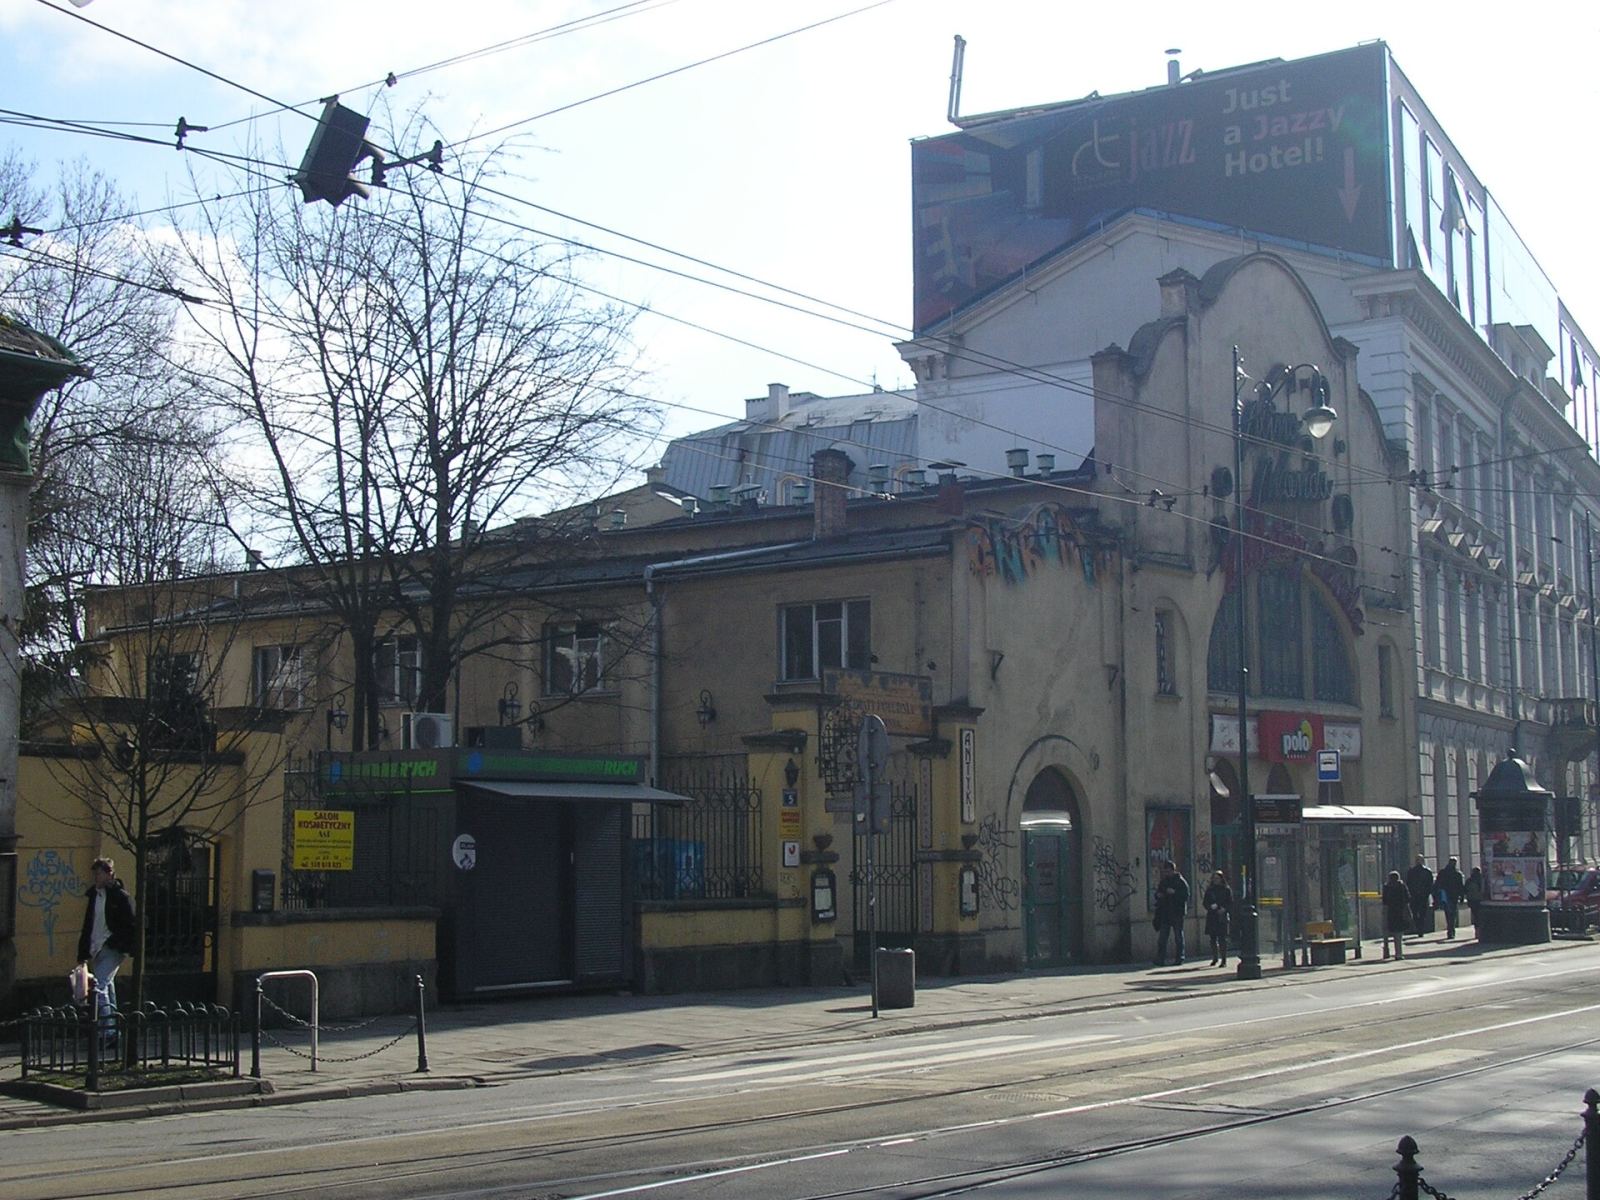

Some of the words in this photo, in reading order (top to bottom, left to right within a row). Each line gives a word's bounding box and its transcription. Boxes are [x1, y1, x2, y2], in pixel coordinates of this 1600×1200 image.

[1222, 79, 1291, 114] Just
[1223, 124, 1241, 145] a
[1254, 105, 1344, 141] Jazzy
[1225, 137, 1324, 177] Hotel!
[1282, 730, 1310, 755] polo
[604, 759, 638, 775] RUCH
[963, 732, 973, 821] ANTYKI
[788, 795, 795, 804] 5
[298, 820, 351, 830] KOSMETYCZNY
[314, 812, 339, 821] SALON
